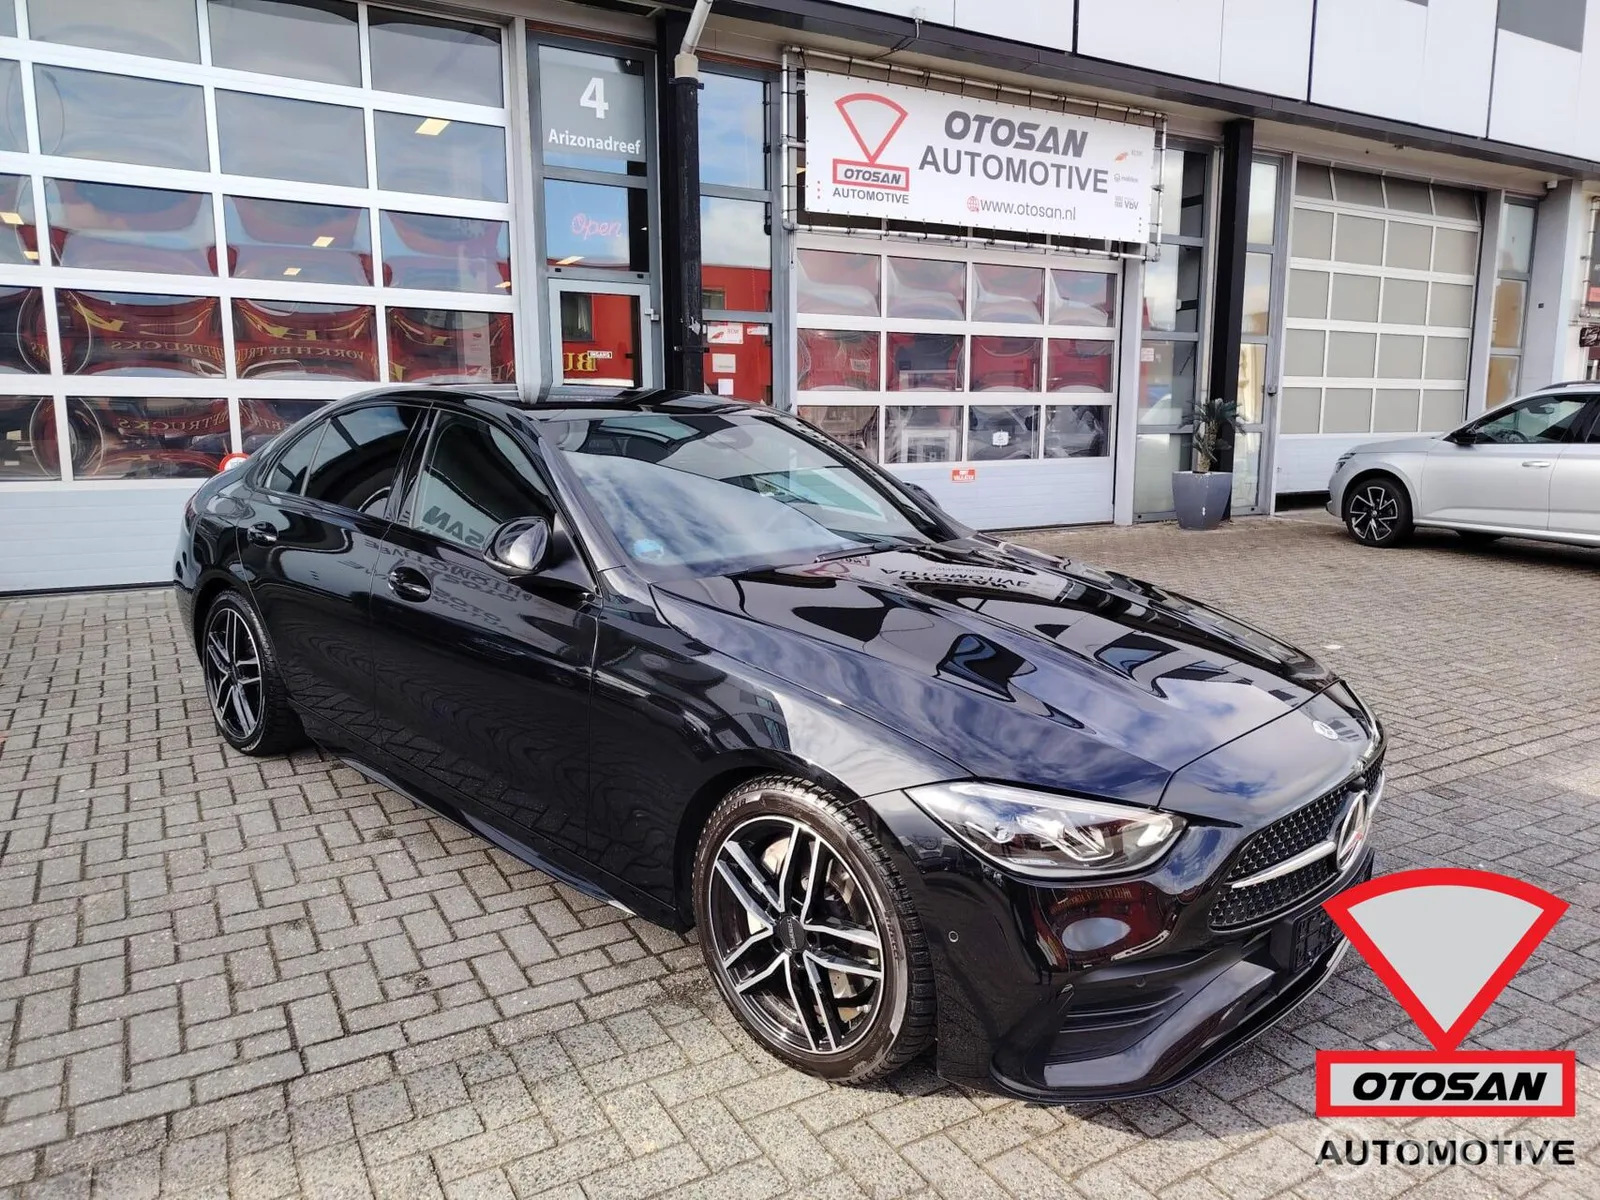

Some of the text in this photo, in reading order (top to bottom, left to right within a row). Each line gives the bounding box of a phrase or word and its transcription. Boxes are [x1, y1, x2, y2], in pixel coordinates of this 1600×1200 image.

[580, 77, 609, 119] 4
[549, 128, 641, 155] Arizonadreef
[944, 110, 1088, 158] OTOSAN
[843, 168, 901, 184] OTOSAN
[918, 146, 1108, 194] AUTOMOTIVE
[832, 187, 909, 204] AUTOMOTIVE
[980, 199, 1076, 220] www.otosan.nl
[571, 213, 623, 240] Open
